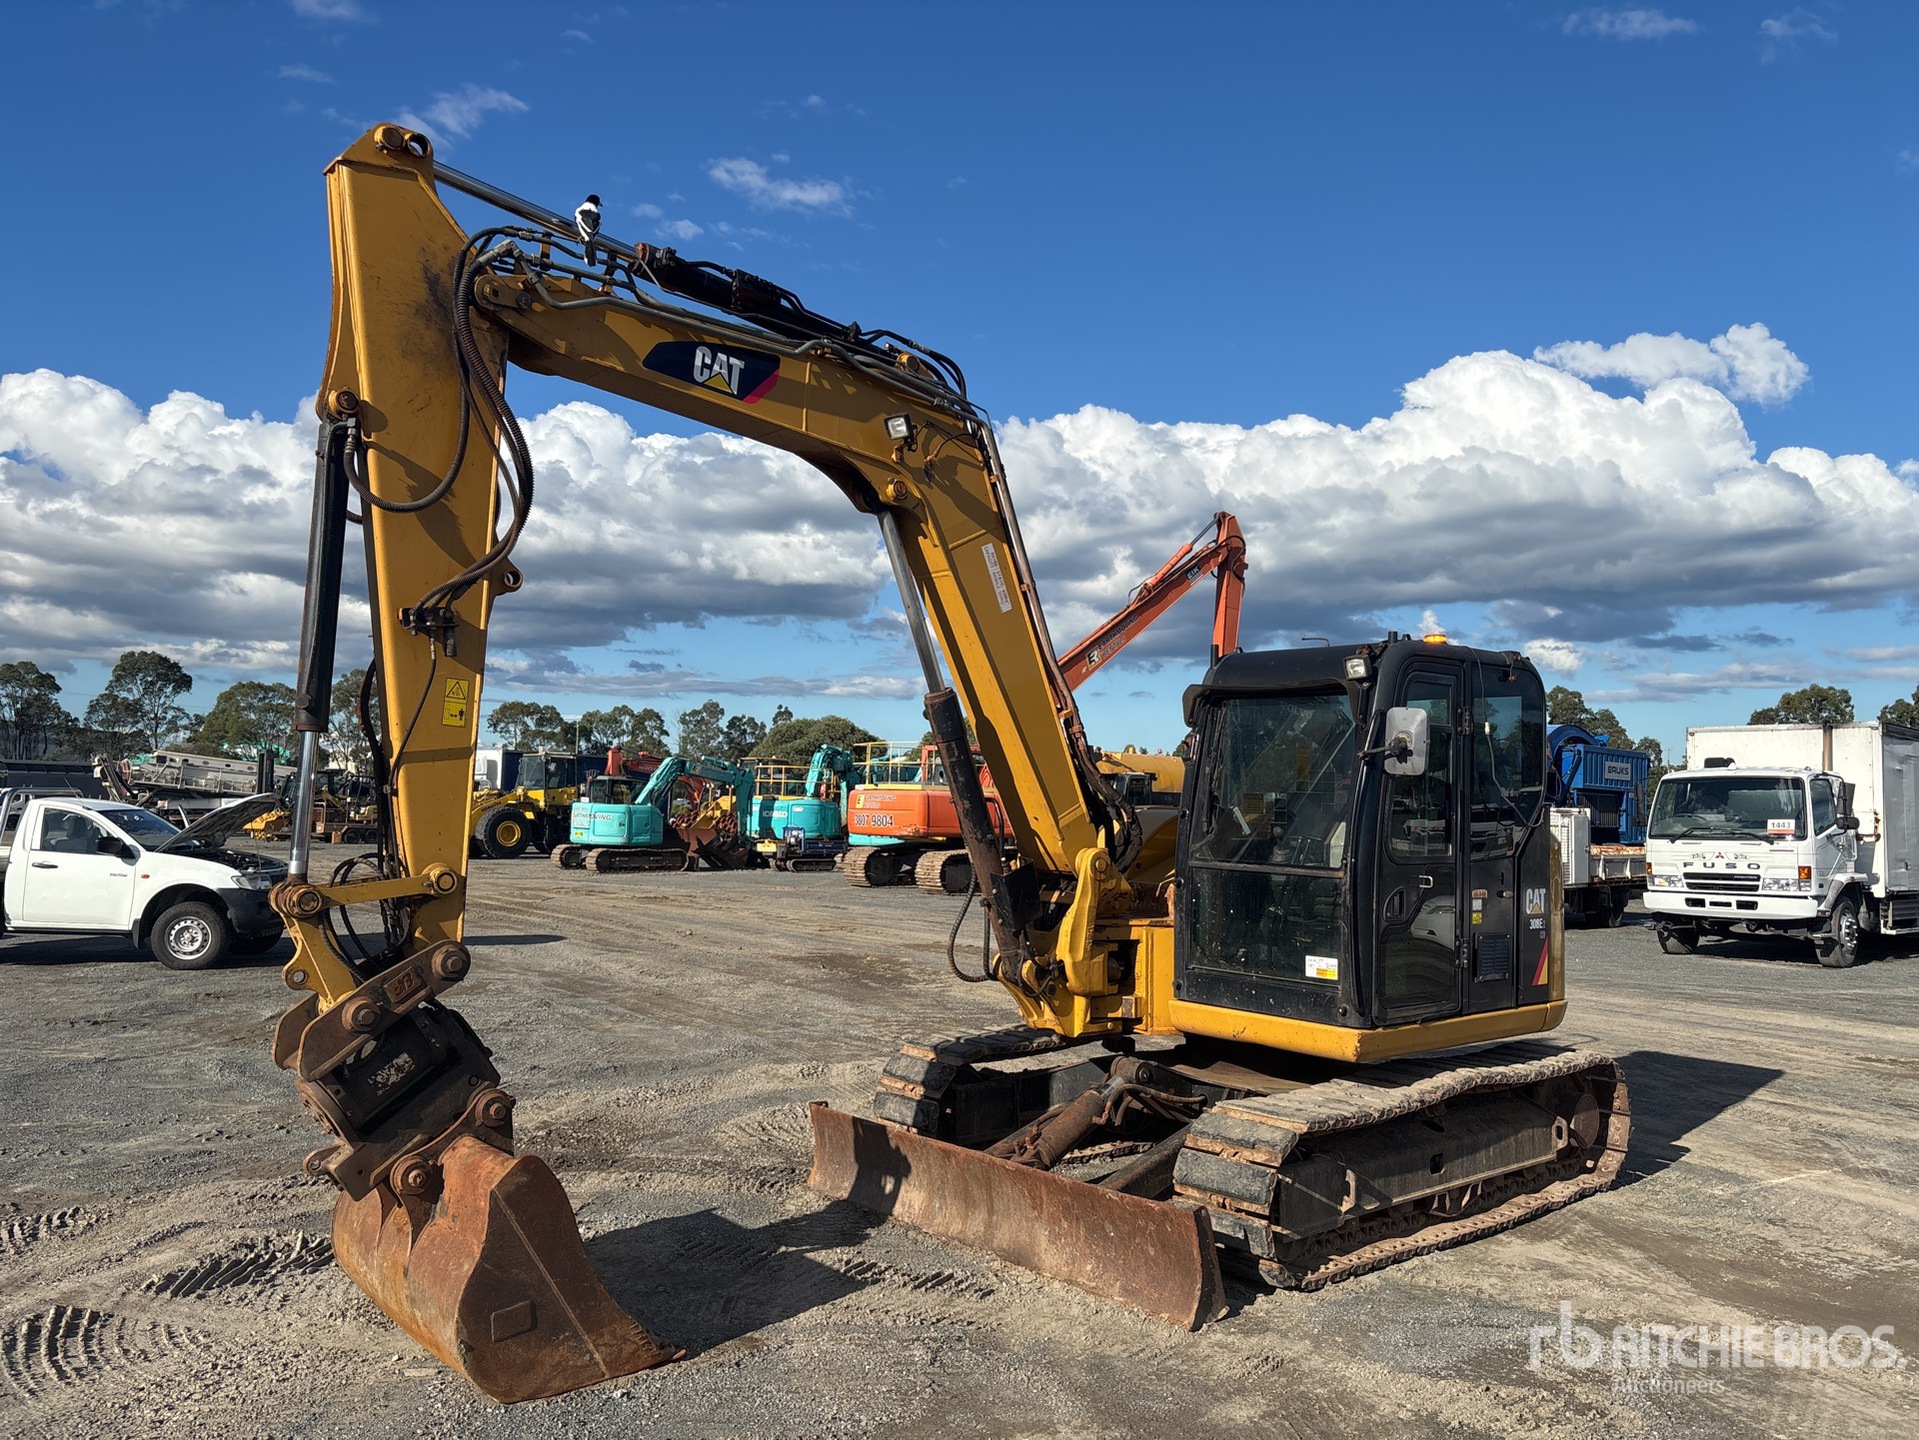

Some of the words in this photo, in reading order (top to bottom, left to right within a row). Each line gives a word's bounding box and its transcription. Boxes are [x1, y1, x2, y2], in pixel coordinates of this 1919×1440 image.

[693, 346, 745, 395] CAT
[1098, 614, 1139, 650] EARTHMOVING
[1607, 765, 1629, 776] BRUKS
[871, 814, 894, 828] 9804
[1683, 861, 1761, 870] FUSO
[1525, 888, 1546, 914] CAT
